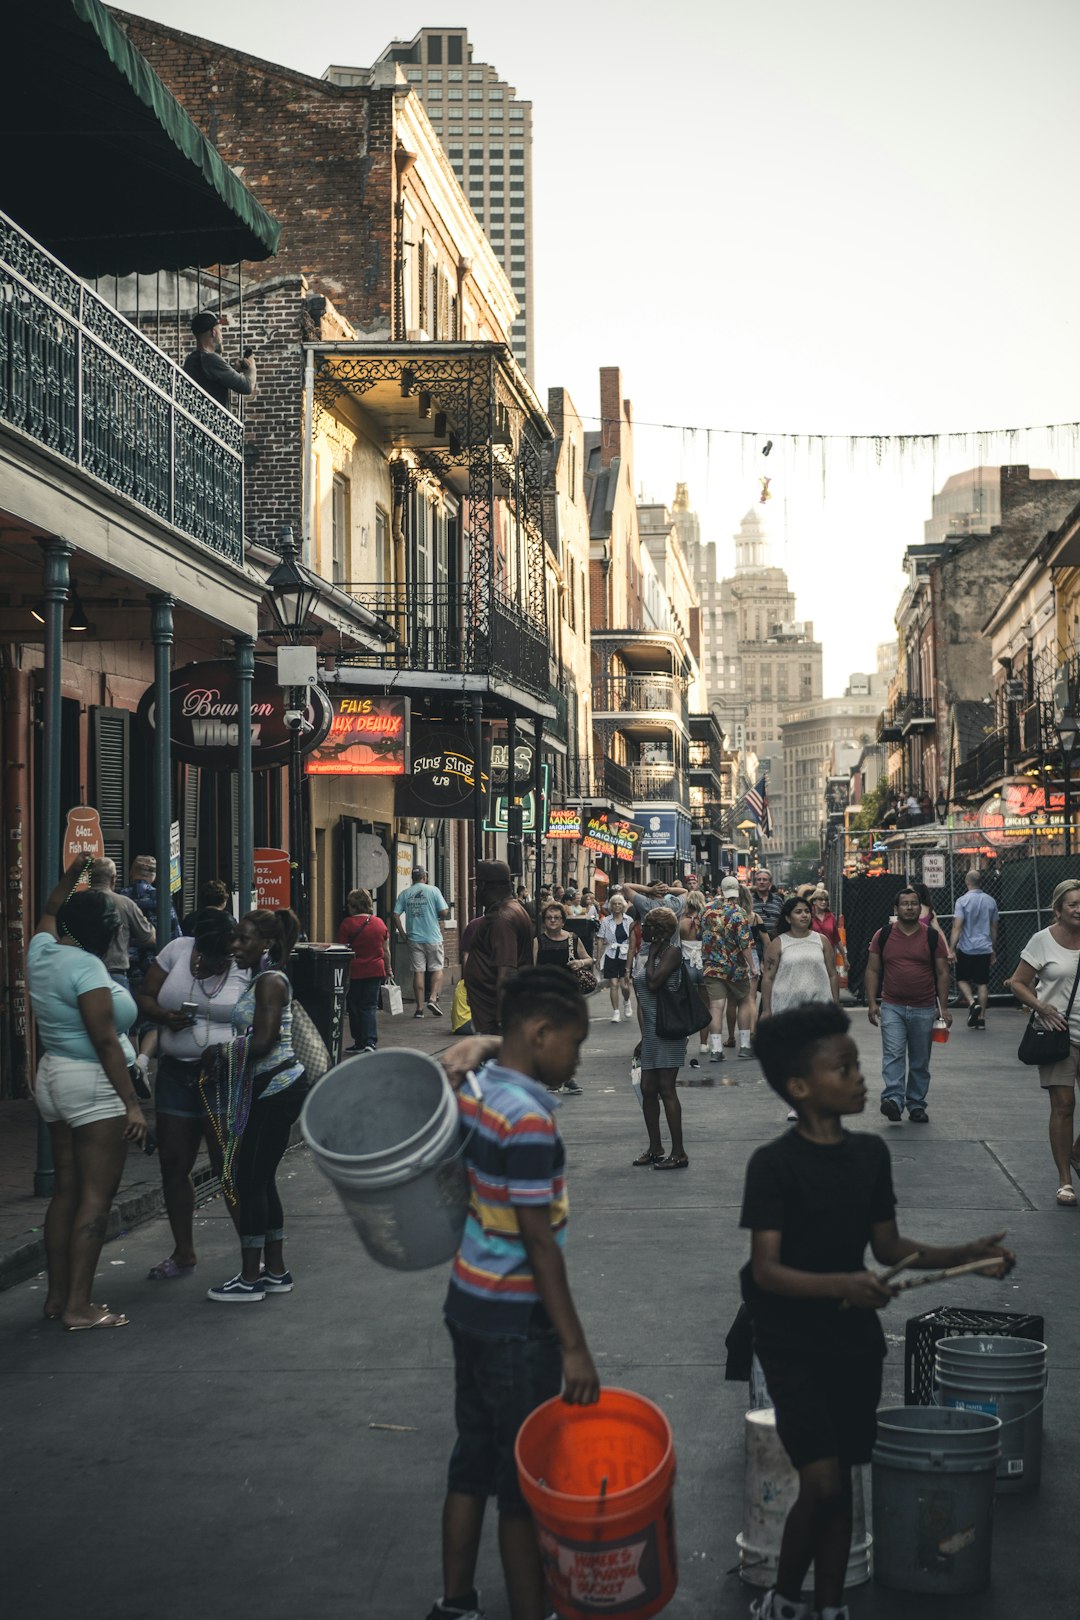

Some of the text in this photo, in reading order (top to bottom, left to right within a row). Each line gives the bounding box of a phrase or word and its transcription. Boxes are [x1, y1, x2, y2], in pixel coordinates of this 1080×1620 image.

[182, 688, 274, 717] Bouron
[339, 699, 373, 714] FAIS
[356, 716, 401, 732] DEAUX
[413, 756, 442, 774] Sing
[445, 757, 474, 775] Sing
[1004, 817, 1030, 825] CHICKEN
[75, 825, 93, 837] 64oz.
[588, 818, 639, 842] MAGO
[68, 840, 99, 854] Fish Bowl
[929, 858, 938, 866] NO
[256, 876, 282, 884] Bowl
